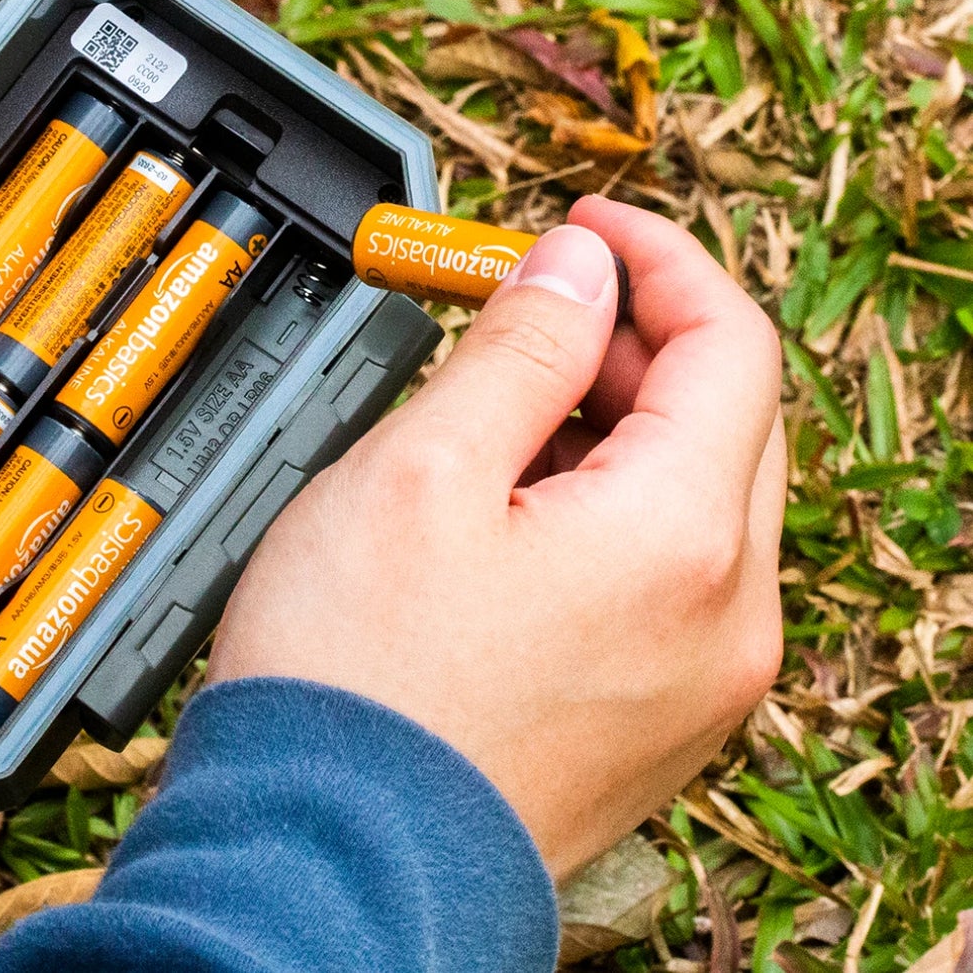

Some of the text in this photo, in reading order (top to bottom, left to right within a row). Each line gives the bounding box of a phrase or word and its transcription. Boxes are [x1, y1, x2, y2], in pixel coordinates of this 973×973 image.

[146, 54, 168, 73] 2122
[128, 75, 150, 94] 0920
[34, 131, 68, 172] CAUTION:
[104, 181, 149, 235] PRECAUCIÓN:
[379, 212, 454, 236] ALKALINE
[219, 261, 247, 291] AA
[368, 230, 515, 282] mazonbasics
[86, 243, 218, 406] amazonbasics
[71, 320, 126, 388] ALKALINE
[145, 373, 158, 390] 1.5V
[164, 354, 254, 463] 1.5V SIZE AA
[68, 531, 82, 547] 1.5V
[8, 511, 141, 678] amazonbasics
